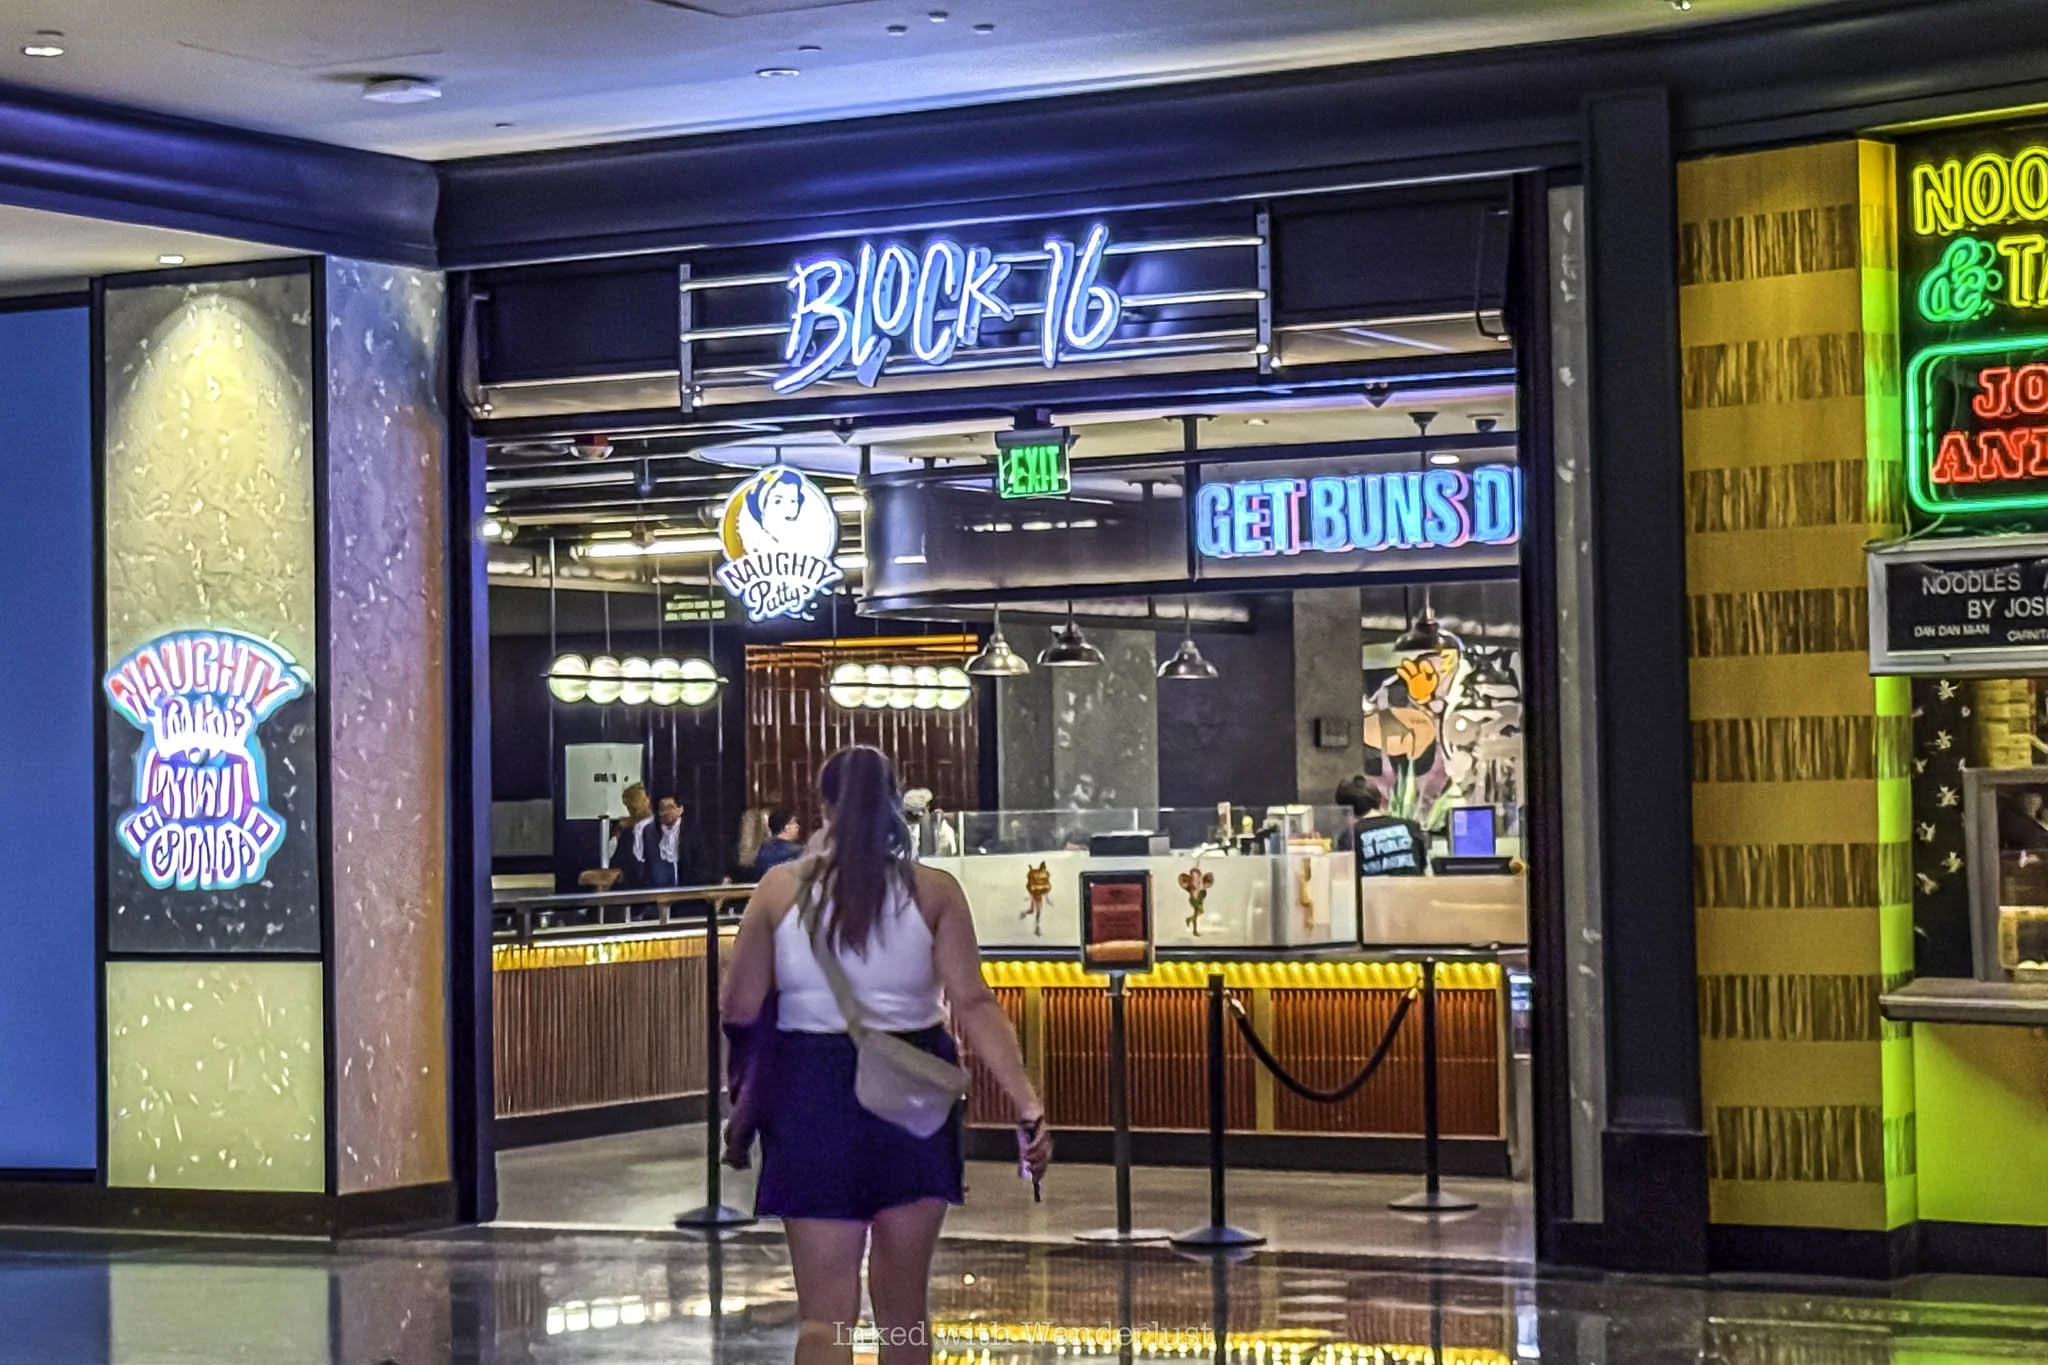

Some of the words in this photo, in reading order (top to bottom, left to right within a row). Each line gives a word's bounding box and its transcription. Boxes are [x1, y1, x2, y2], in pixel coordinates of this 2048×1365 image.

[773, 240, 1013, 394] BLOCK
[1041, 222, 1121, 369] 16
[1010, 445, 1060, 494] EXIT
[1195, 477, 1306, 559] GET
[1310, 467, 1470, 553] BUNS
[724, 553, 837, 590] NAUGHTY
[1922, 572, 2021, 595] NOODLES
[1967, 598, 1996, 619] BY
[2004, 595, 2048, 618] JOS
[105, 636, 299, 724] NAUGHTY
